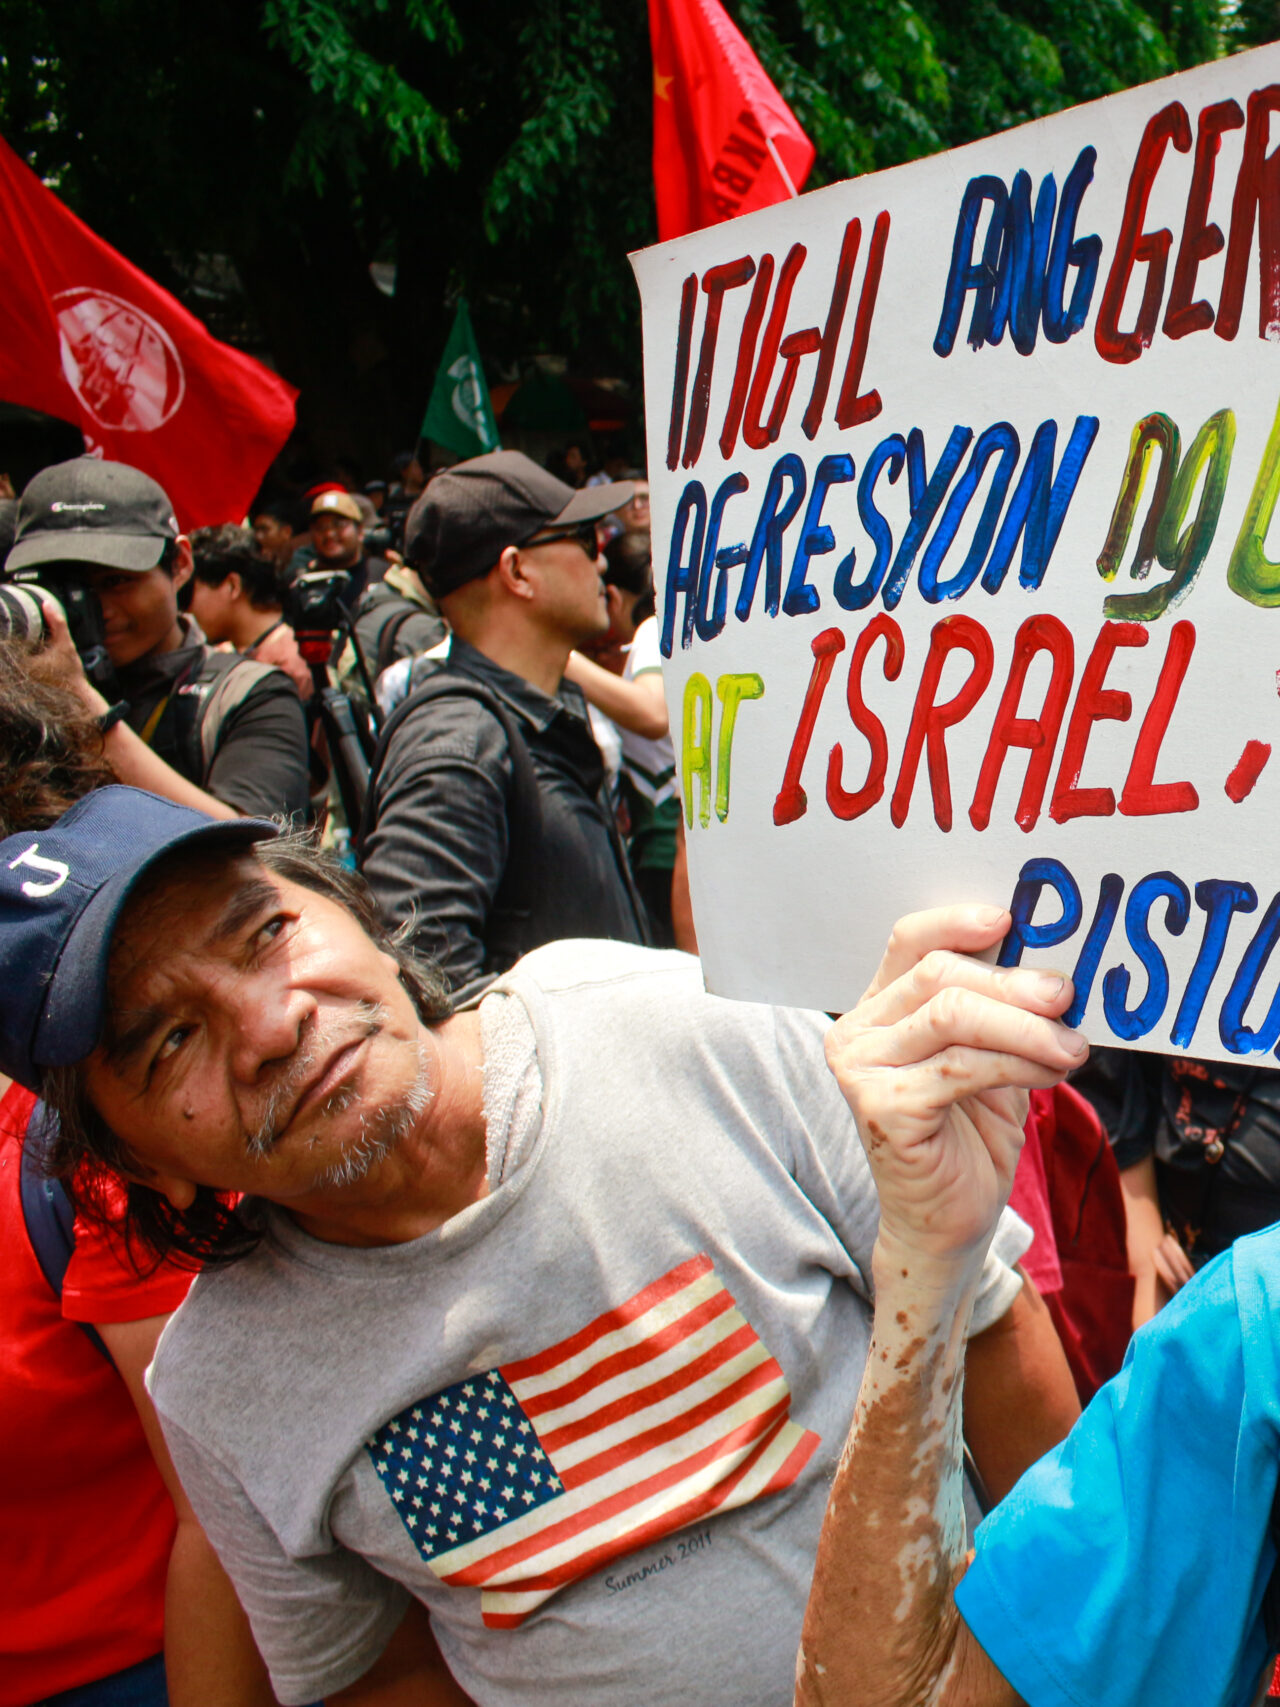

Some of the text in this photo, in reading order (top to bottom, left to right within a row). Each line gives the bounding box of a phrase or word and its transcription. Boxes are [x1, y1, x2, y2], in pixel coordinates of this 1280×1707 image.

[667, 209, 891, 471] ITIGIL
[933, 145, 1103, 358] ANG
[660, 415, 1100, 659] AGRESYON
[681, 671, 766, 830] AT
[8, 842, 71, 898] J
[604, 1554, 676, 1597] Summer
